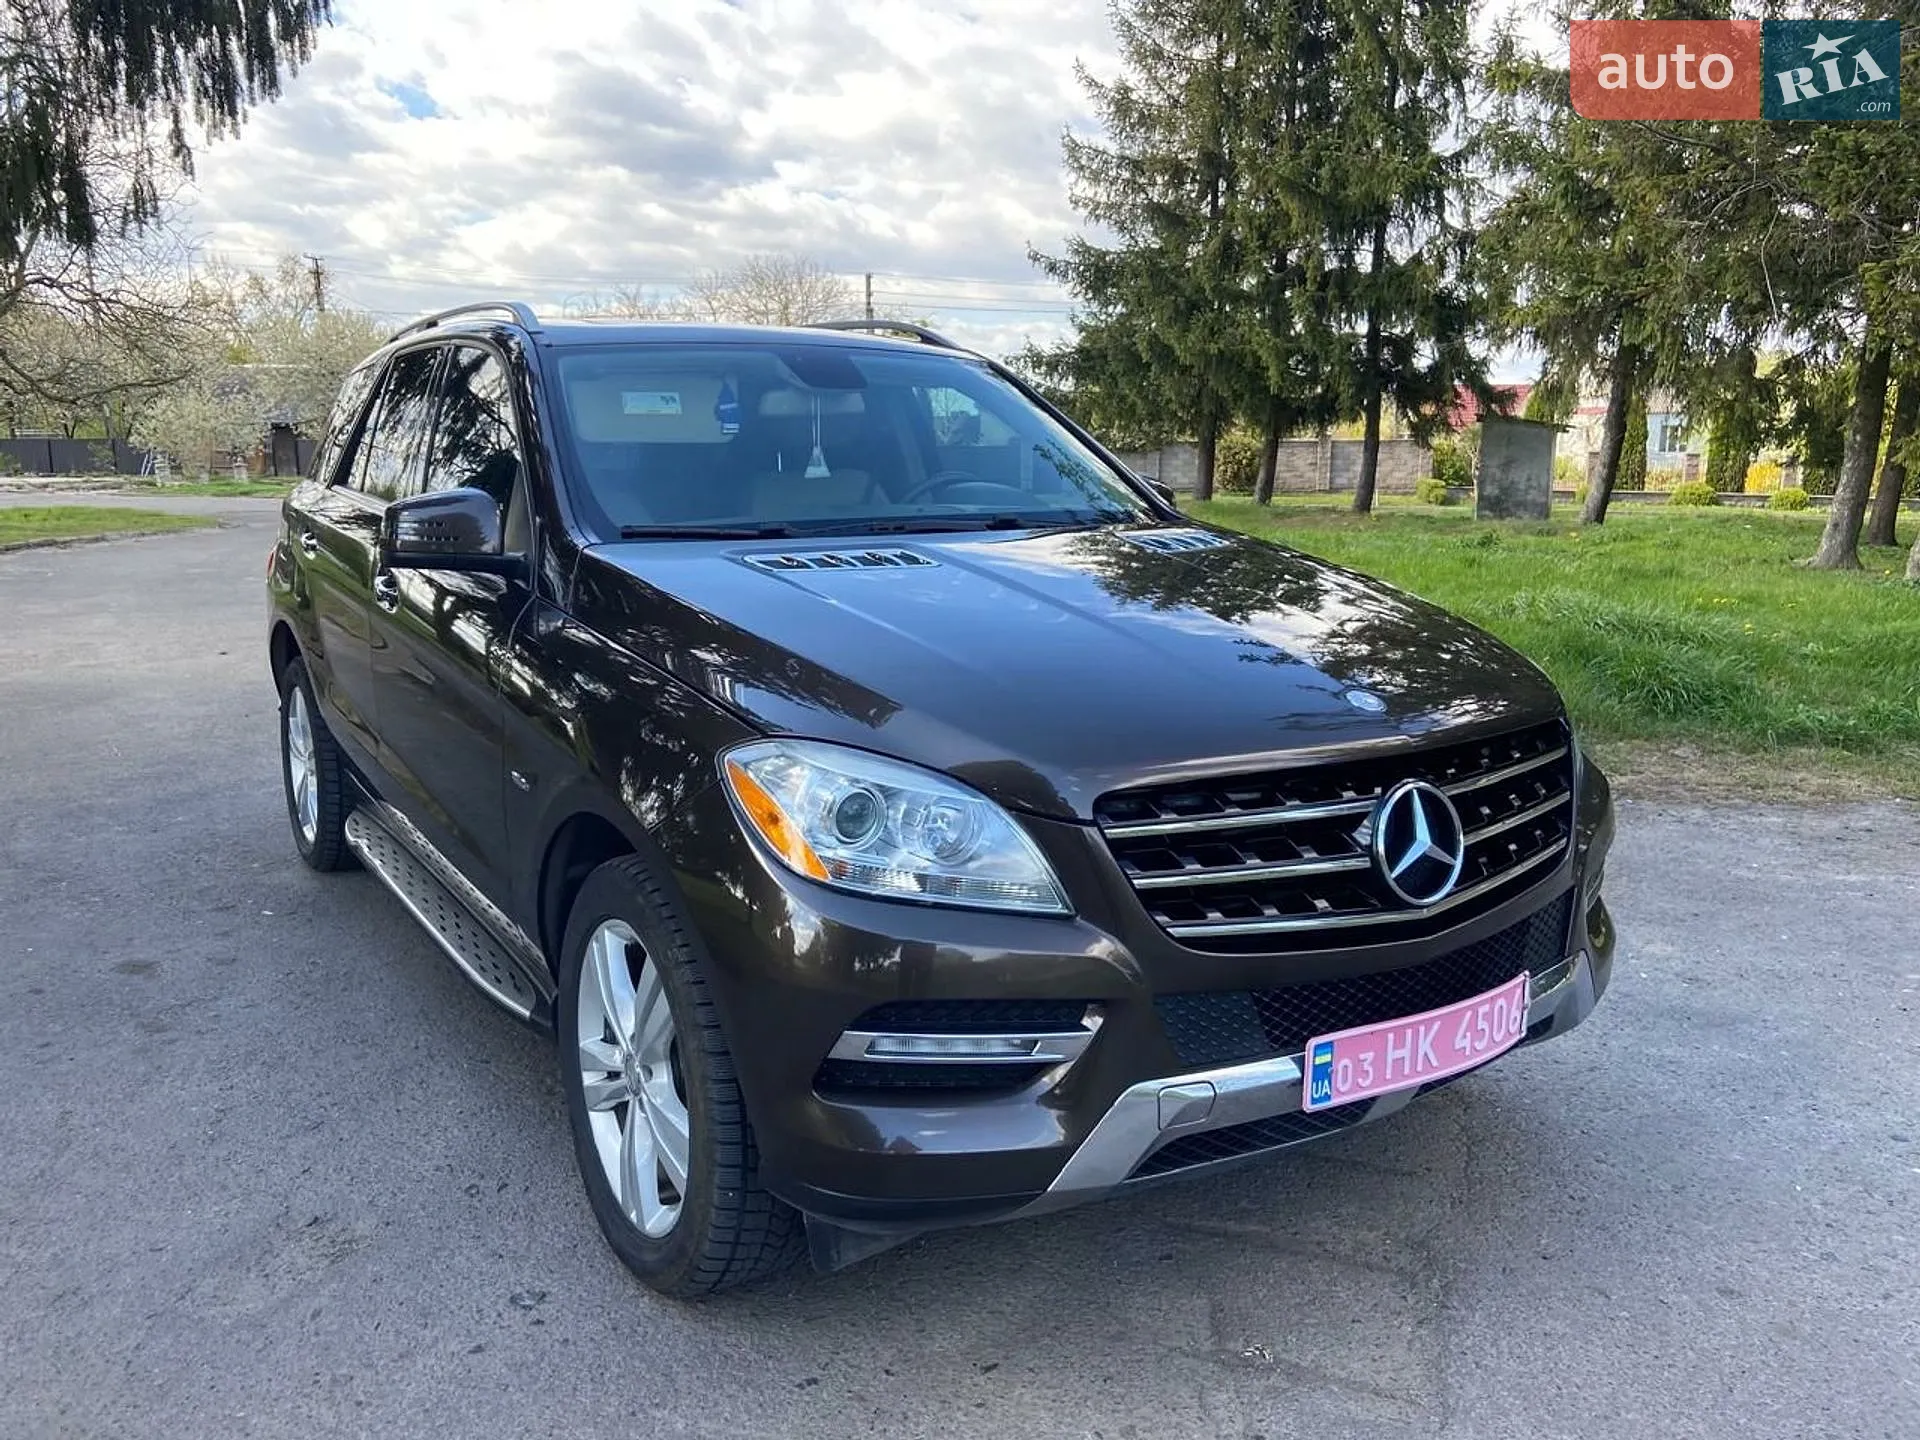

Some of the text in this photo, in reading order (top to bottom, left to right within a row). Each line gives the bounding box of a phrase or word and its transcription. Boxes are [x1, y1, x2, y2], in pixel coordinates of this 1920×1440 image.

[1336, 989, 1522, 1092] 03 HK 4506
[1312, 1081, 1331, 1098] UA
